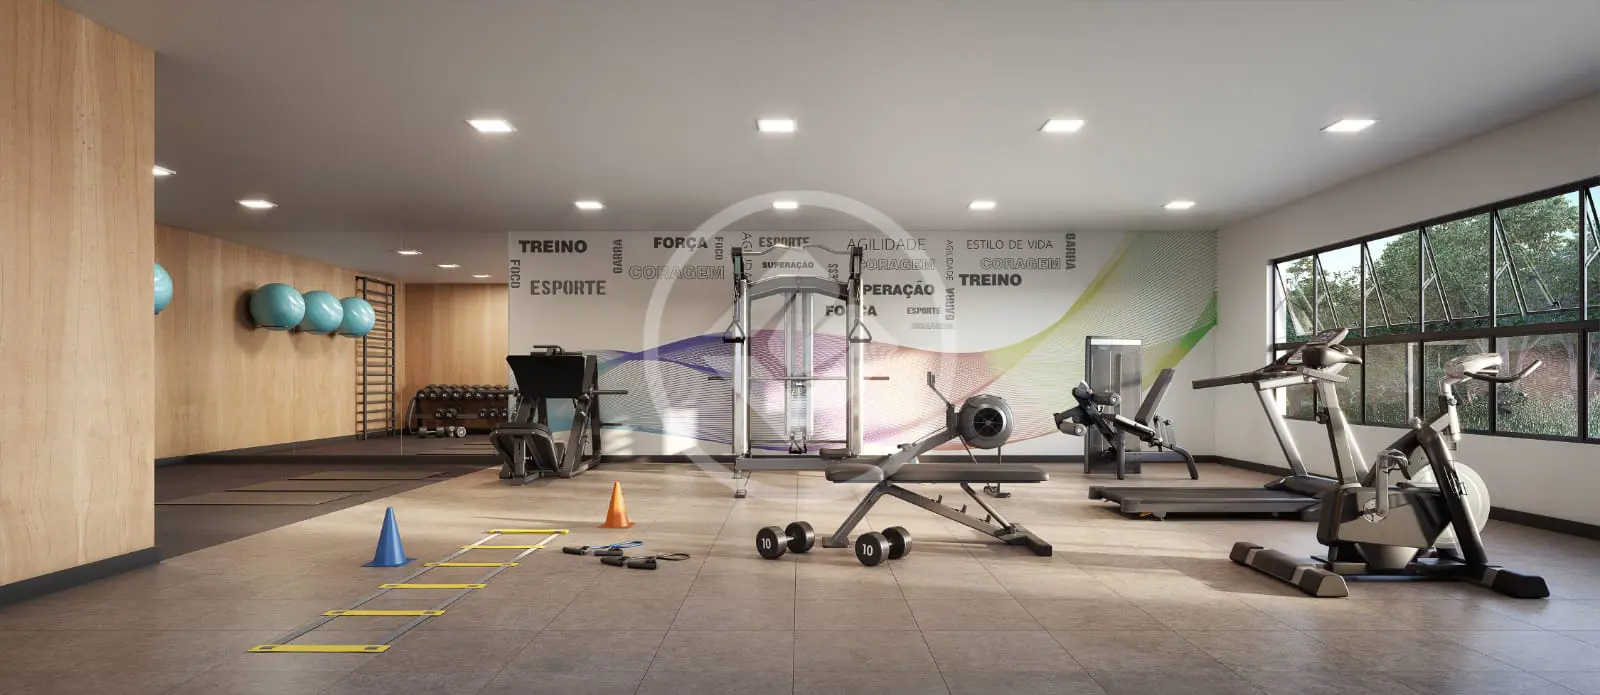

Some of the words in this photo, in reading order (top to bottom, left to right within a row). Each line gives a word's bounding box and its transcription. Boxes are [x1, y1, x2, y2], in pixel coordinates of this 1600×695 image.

[518, 240, 588, 253] TREINO
[653, 236, 709, 252] FORÇA
[714, 236, 724, 261] FOCO
[759, 236, 811, 248] ESPORTE
[846, 238, 926, 251] AGILIDADE
[966, 239, 1004, 250] ESTILO
[1008, 239, 1023, 250] DE
[1027, 239, 1053, 250] VIDA
[612, 239, 623, 274] GARRA
[1065, 233, 1076, 270] GARRA
[762, 260, 814, 270] SUPERAÇÃO
[980, 257, 1062, 270] CORAGEM
[509, 259, 521, 289] FOCO
[628, 265, 725, 280] CORAGEM
[958, 273, 1022, 287] TREINO
[530, 279, 607, 296] ESPORTE
[862, 280, 935, 299] PERAÇÃO
[825, 304, 878, 317] FOA
[906, 306, 942, 315] ESPORTE
[761, 537, 772, 550] 10
[862, 543, 873, 557] 10
